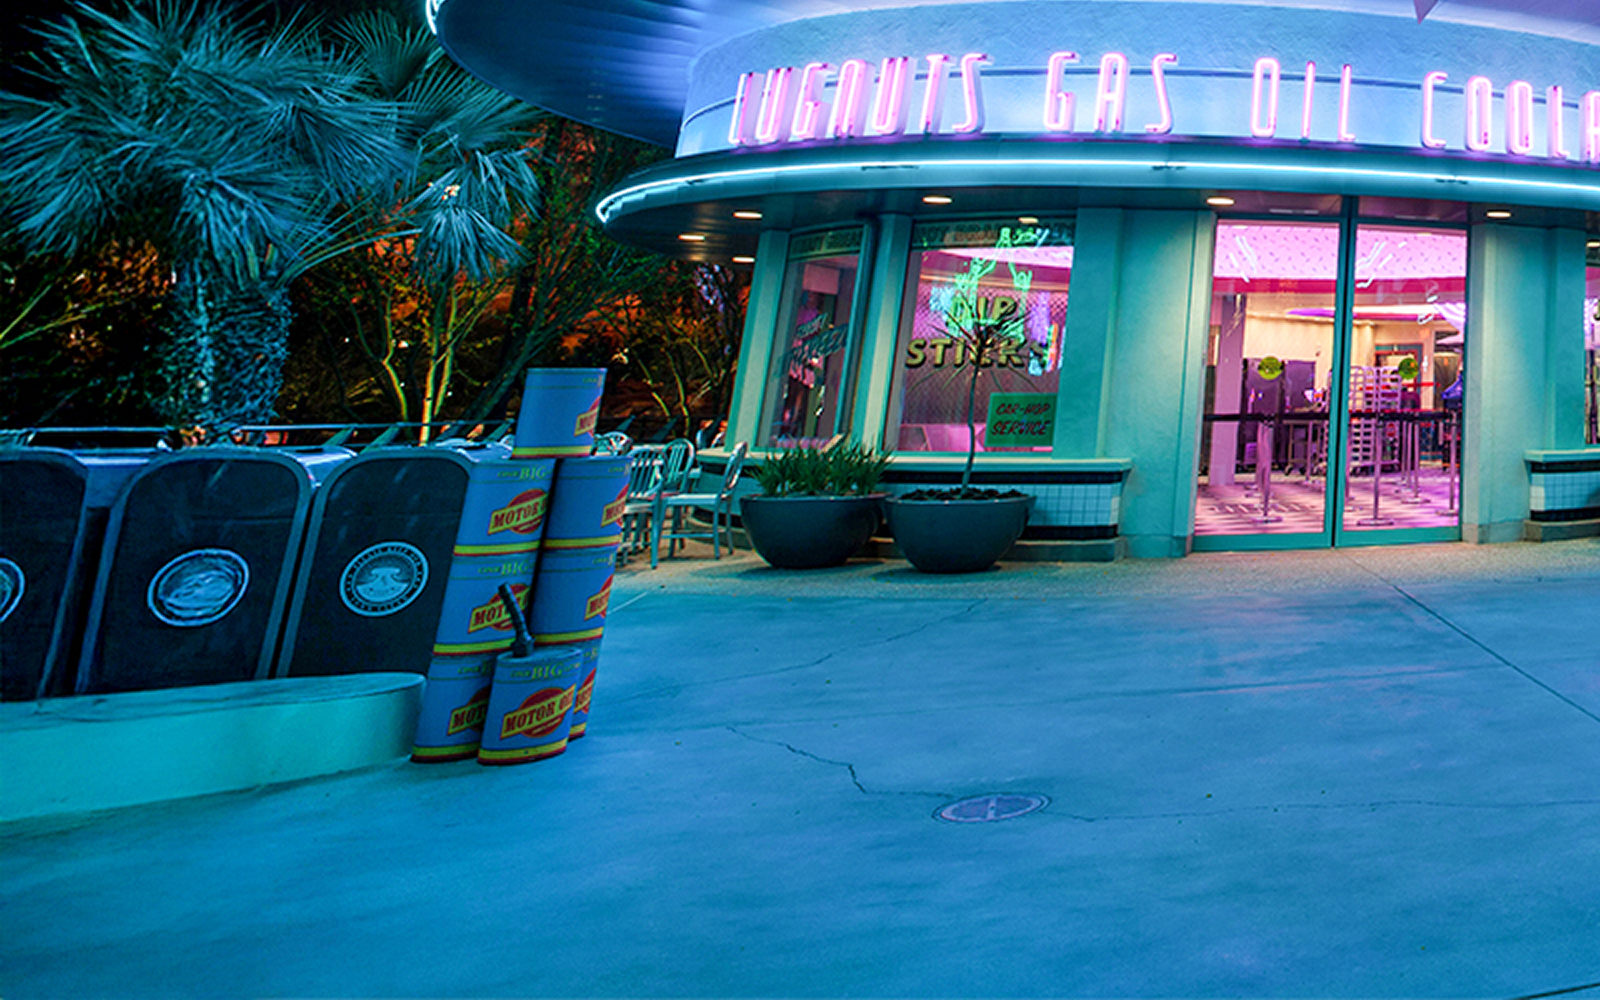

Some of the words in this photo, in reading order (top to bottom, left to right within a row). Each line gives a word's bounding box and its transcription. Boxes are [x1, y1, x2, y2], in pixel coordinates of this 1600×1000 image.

[728, 53, 992, 146] LUGNUTS
[1042, 52, 1178, 135] GAS
[1250, 57, 1356, 142] OIL
[991, 420, 1052, 436] SERVICE
[493, 502, 541, 529] MOTOR
[532, 663, 562, 680] BIG
[505, 701, 555, 730] MOTOR
